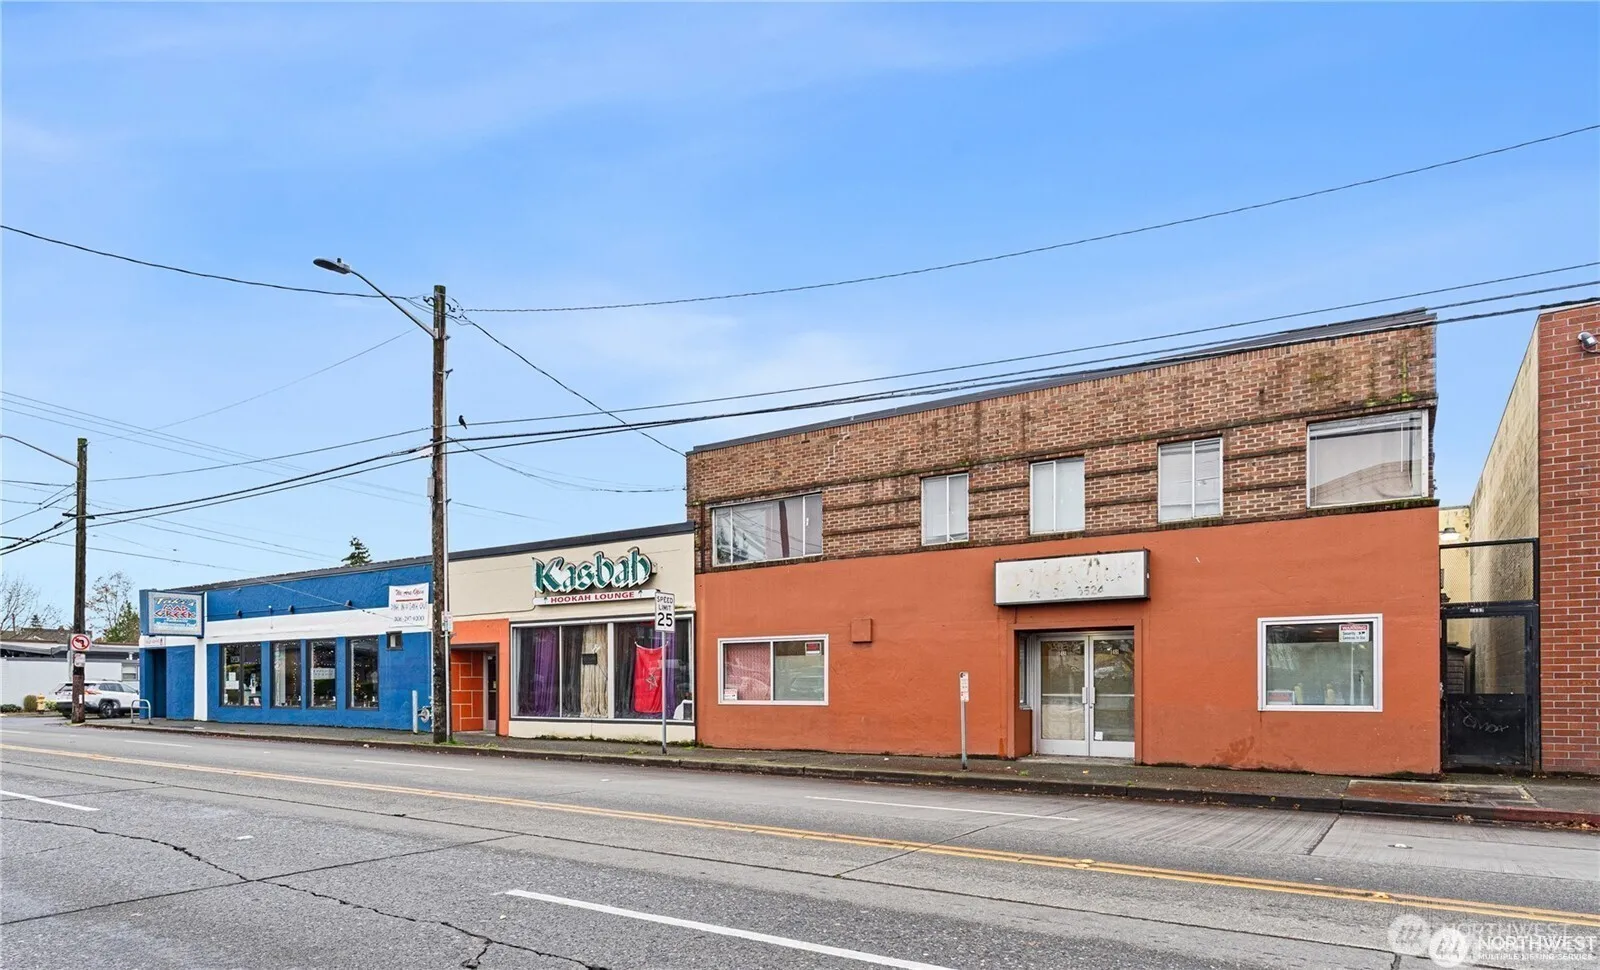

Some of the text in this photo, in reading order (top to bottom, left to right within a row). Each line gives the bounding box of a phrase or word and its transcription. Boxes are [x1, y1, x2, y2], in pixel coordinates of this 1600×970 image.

[532, 547, 651, 594] Kasbah
[550, 591, 635, 604] HOOKAH LOUNGE
[656, 595, 674, 604] SPEED
[154, 609, 197, 619] GREEK
[657, 612, 674, 627] 25
